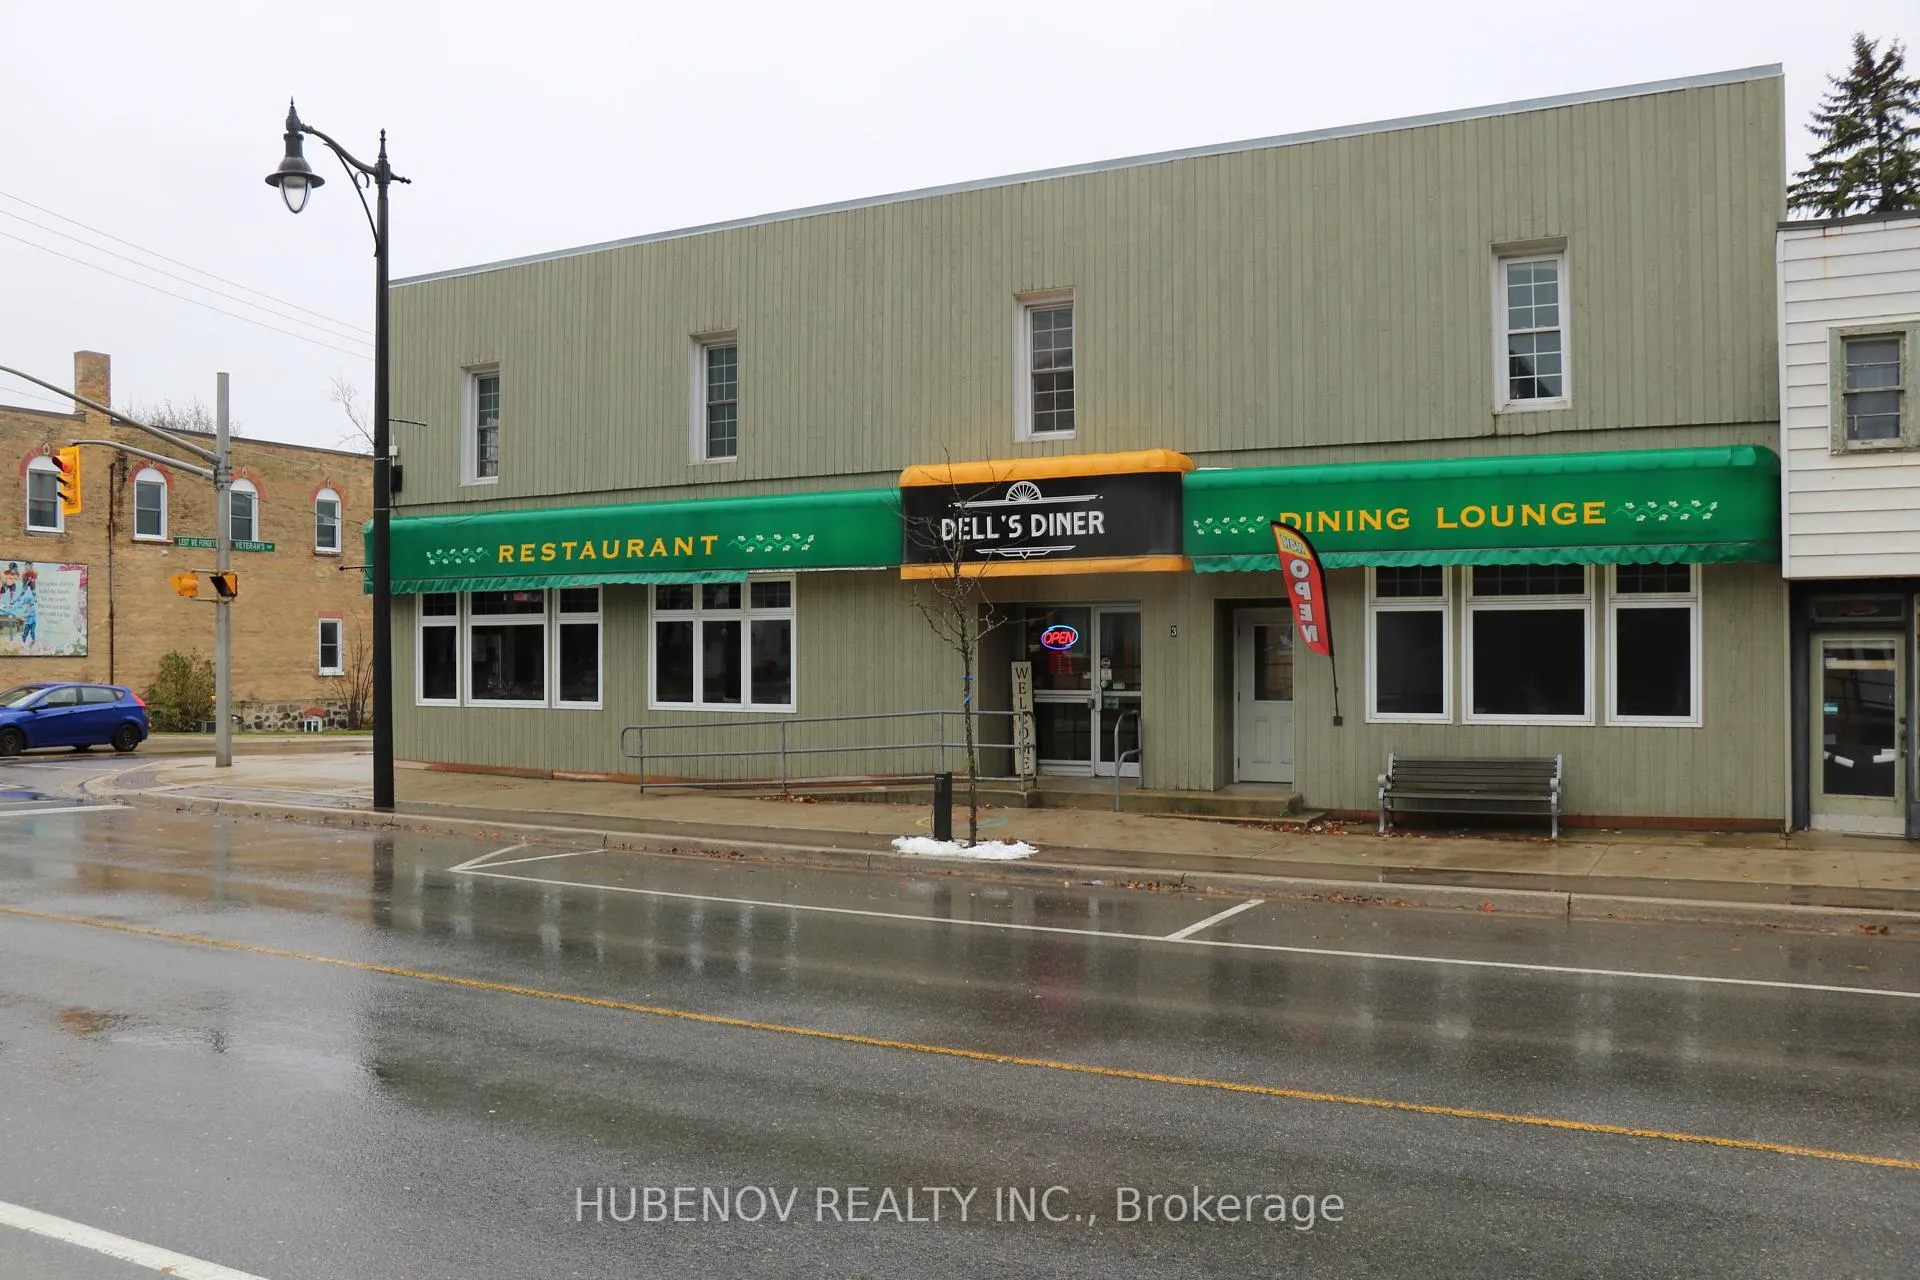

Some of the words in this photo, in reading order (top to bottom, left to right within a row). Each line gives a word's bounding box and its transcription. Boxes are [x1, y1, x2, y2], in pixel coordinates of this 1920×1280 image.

[1280, 507, 1410, 533] DINING
[1436, 501, 1606, 529] LOUNGE
[941, 514, 1023, 541] DELL'S
[1030, 510, 1105, 538] DINER
[190, 538, 198, 547] WE
[198, 539, 215, 547] FORGET
[235, 541, 265, 550] VETERAN'S
[498, 534, 718, 563] RESTAURANT
[1043, 631, 1075, 644] OPEN
[1171, 626, 1177, 637] 3
